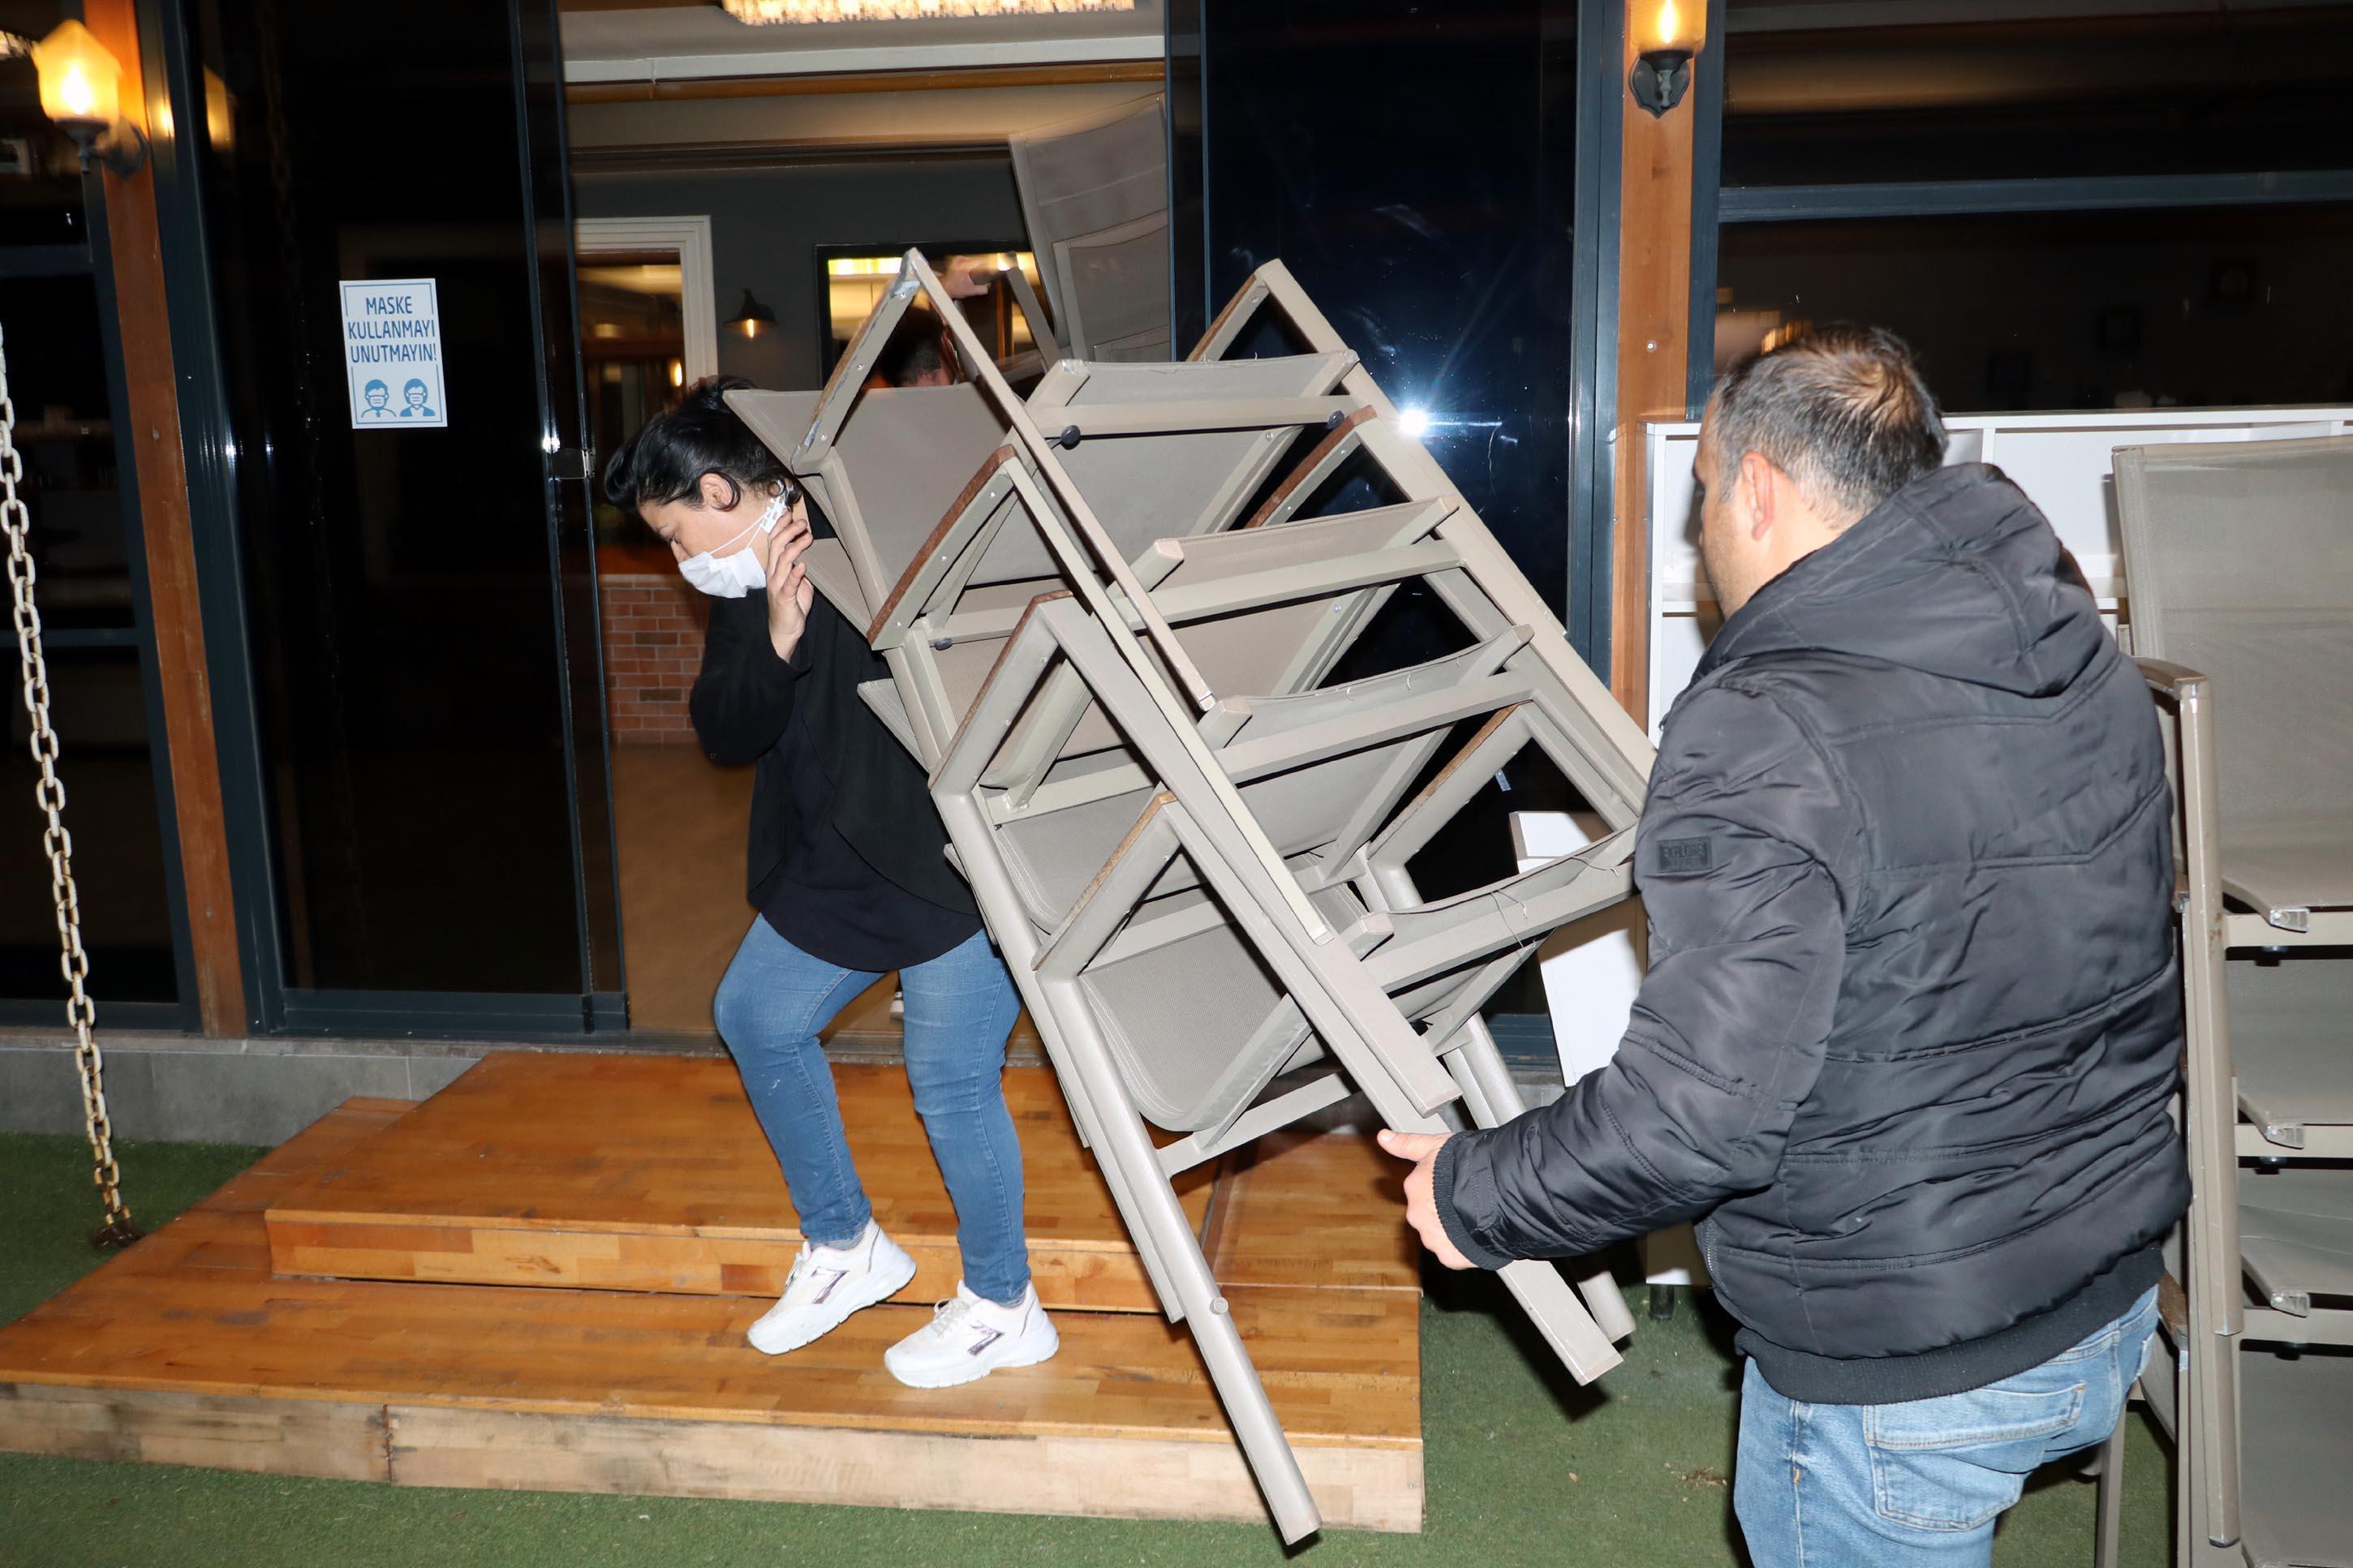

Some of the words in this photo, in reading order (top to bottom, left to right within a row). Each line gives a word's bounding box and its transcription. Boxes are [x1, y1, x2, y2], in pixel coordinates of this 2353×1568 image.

[366, 296, 413, 316] MASKE
[347, 320, 436, 339] KULLANMAYI
[350, 343, 437, 363] UNUTMAYIN!
